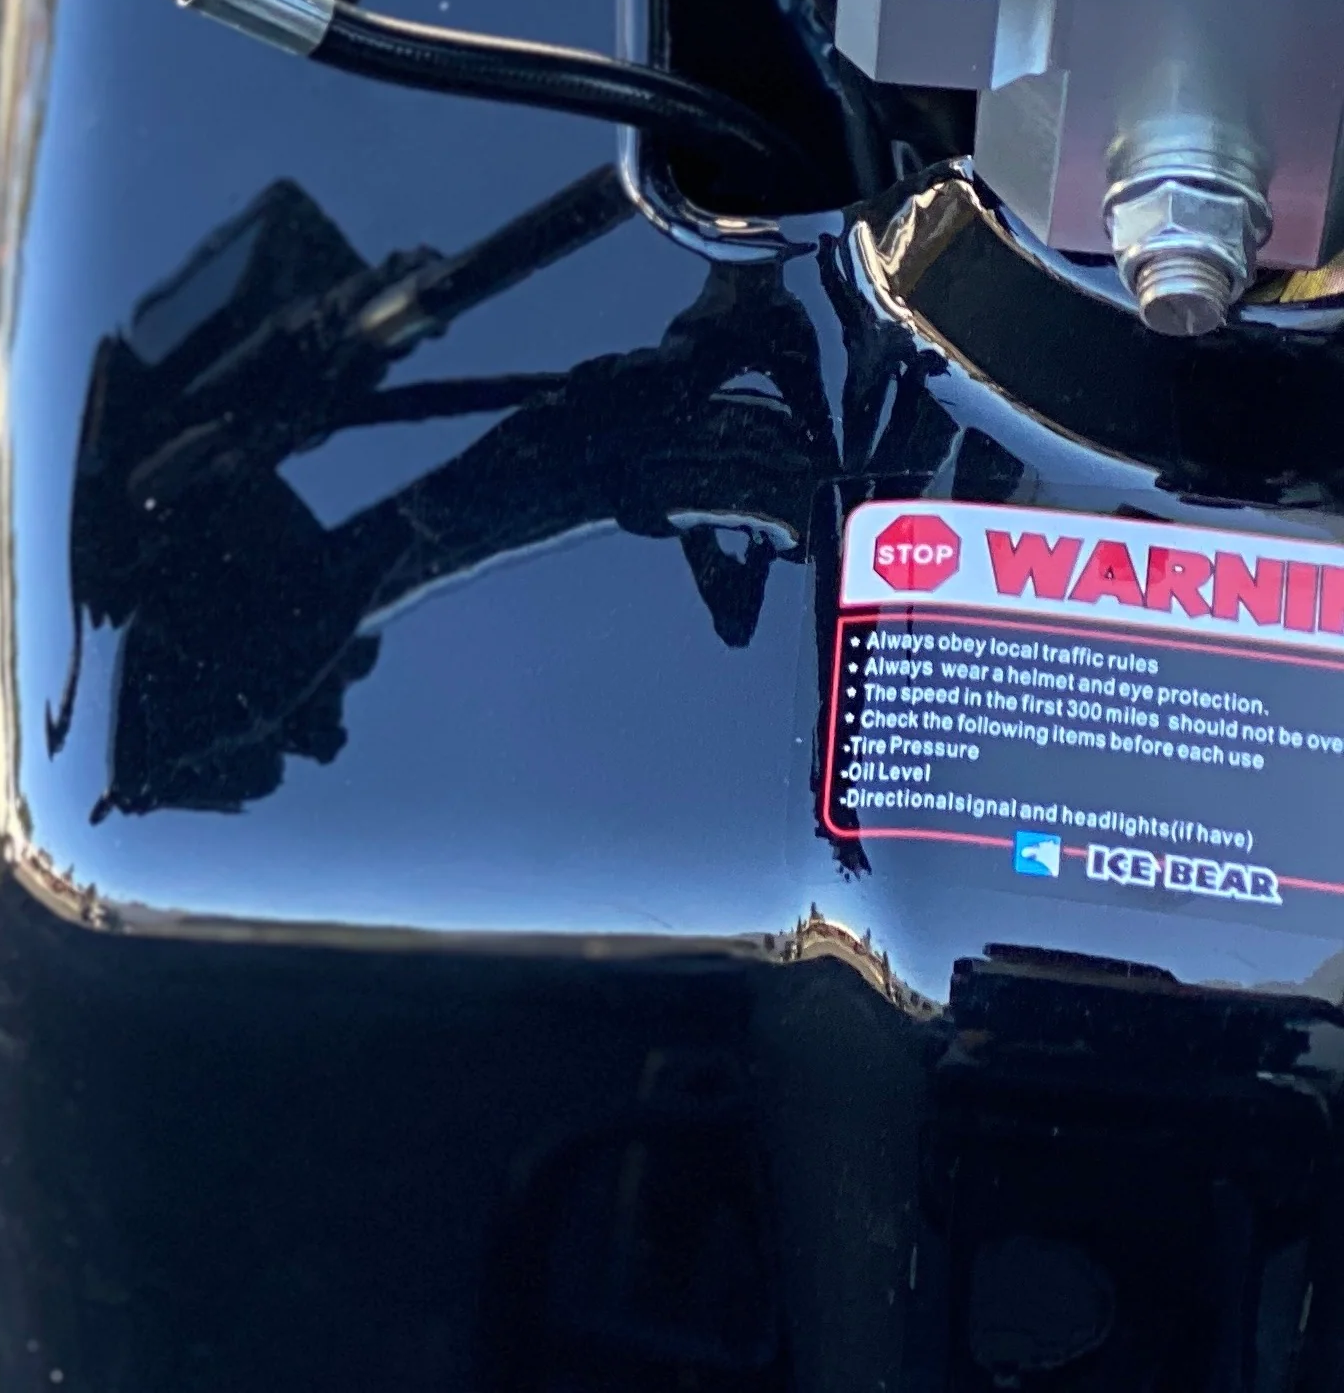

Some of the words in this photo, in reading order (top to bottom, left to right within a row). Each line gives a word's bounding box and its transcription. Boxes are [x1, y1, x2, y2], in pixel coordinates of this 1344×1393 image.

[877, 544, 954, 566] STOP
[865, 630, 935, 654] Always
[938, 632, 987, 658] obey
[990, 636, 1039, 660] local
[1042, 642, 1104, 669] traffic
[1108, 653, 1159, 675] rules
[864, 656, 934, 679] Always
[941, 662, 989, 681] wear
[992, 667, 1004, 683] a
[1007, 665, 1075, 692] helmet
[1078, 676, 1116, 696] and
[1118, 681, 1154, 703] eye
[1157, 685, 1270, 716] protection.
[860, 708, 918, 729] Check
[922, 711, 953, 731] the
[957, 713, 1049, 745] following
[1053, 724, 1106, 749] items
[1110, 730, 1174, 757] before
[1177, 745, 1224, 764] each
[1228, 751, 1265, 770] use
[864, 683, 897, 702] The
[900, 685, 960, 706] speed
[964, 686, 982, 706] in
[986, 690, 1018, 711] the
[1021, 694, 1063, 716] first
[1066, 699, 1102, 722] 300
[1106, 706, 1160, 728] miles
[1168, 713, 1238, 739] should
[1242, 725, 1275, 745] not
[1278, 726, 1303, 748] be
[878, 761, 931, 783] Level
[890, 734, 980, 760] Pressure
[1019, 804, 1058, 823] and
[1196, 821, 1254, 855] have)
[1086, 843, 1162, 888] ICE
[1163, 853, 1284, 905] BEAR
